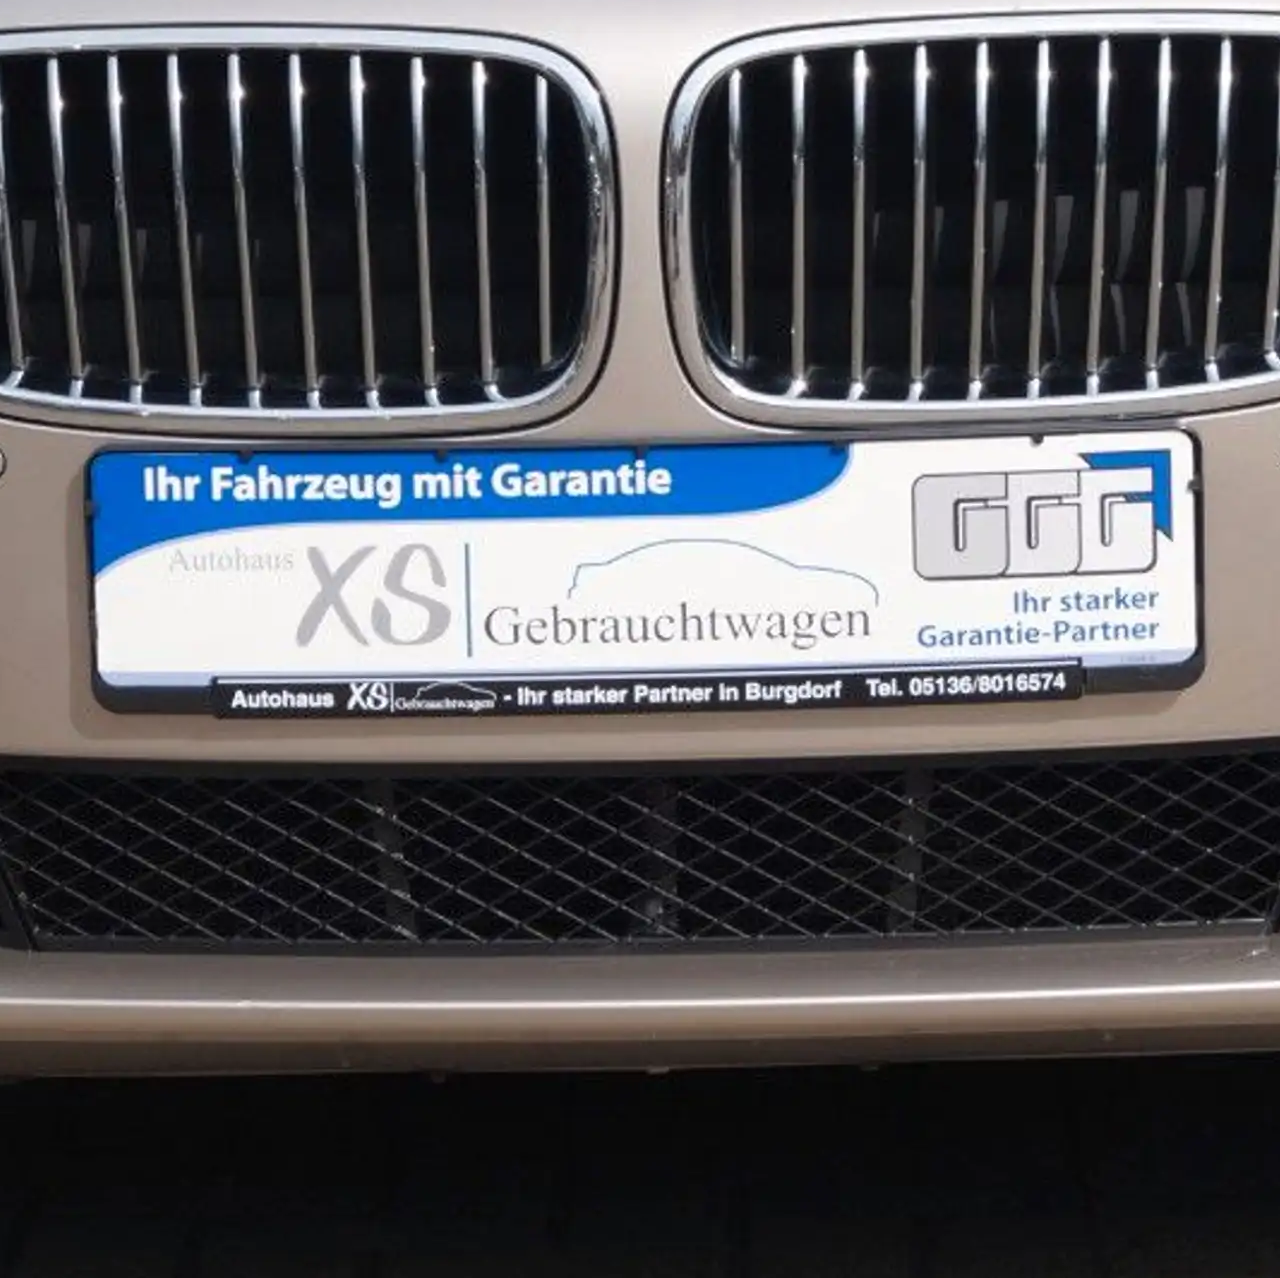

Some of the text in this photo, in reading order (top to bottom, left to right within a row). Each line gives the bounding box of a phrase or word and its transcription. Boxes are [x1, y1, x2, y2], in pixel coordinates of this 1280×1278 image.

[143, 462, 672, 509] Ihr Fahrzeug mit Garantie
[168, 542, 452, 647] Autohaus XS
[1013, 589, 1159, 613] Ihr starker
[484, 600, 871, 650] Gebrauchtwagen
[917, 621, 1160, 648] Garantie-Partner
[231, 689, 335, 709] Autohaus
[347, 682, 389, 710] XS
[517, 687, 544, 705] Ihr
[551, 684, 627, 705] starker
[634, 683, 713, 703] Partner
[745, 679, 841, 704] Burgdorf
[867, 678, 903, 698] Tel.
[909, 674, 1066, 696] 05136/8016574
